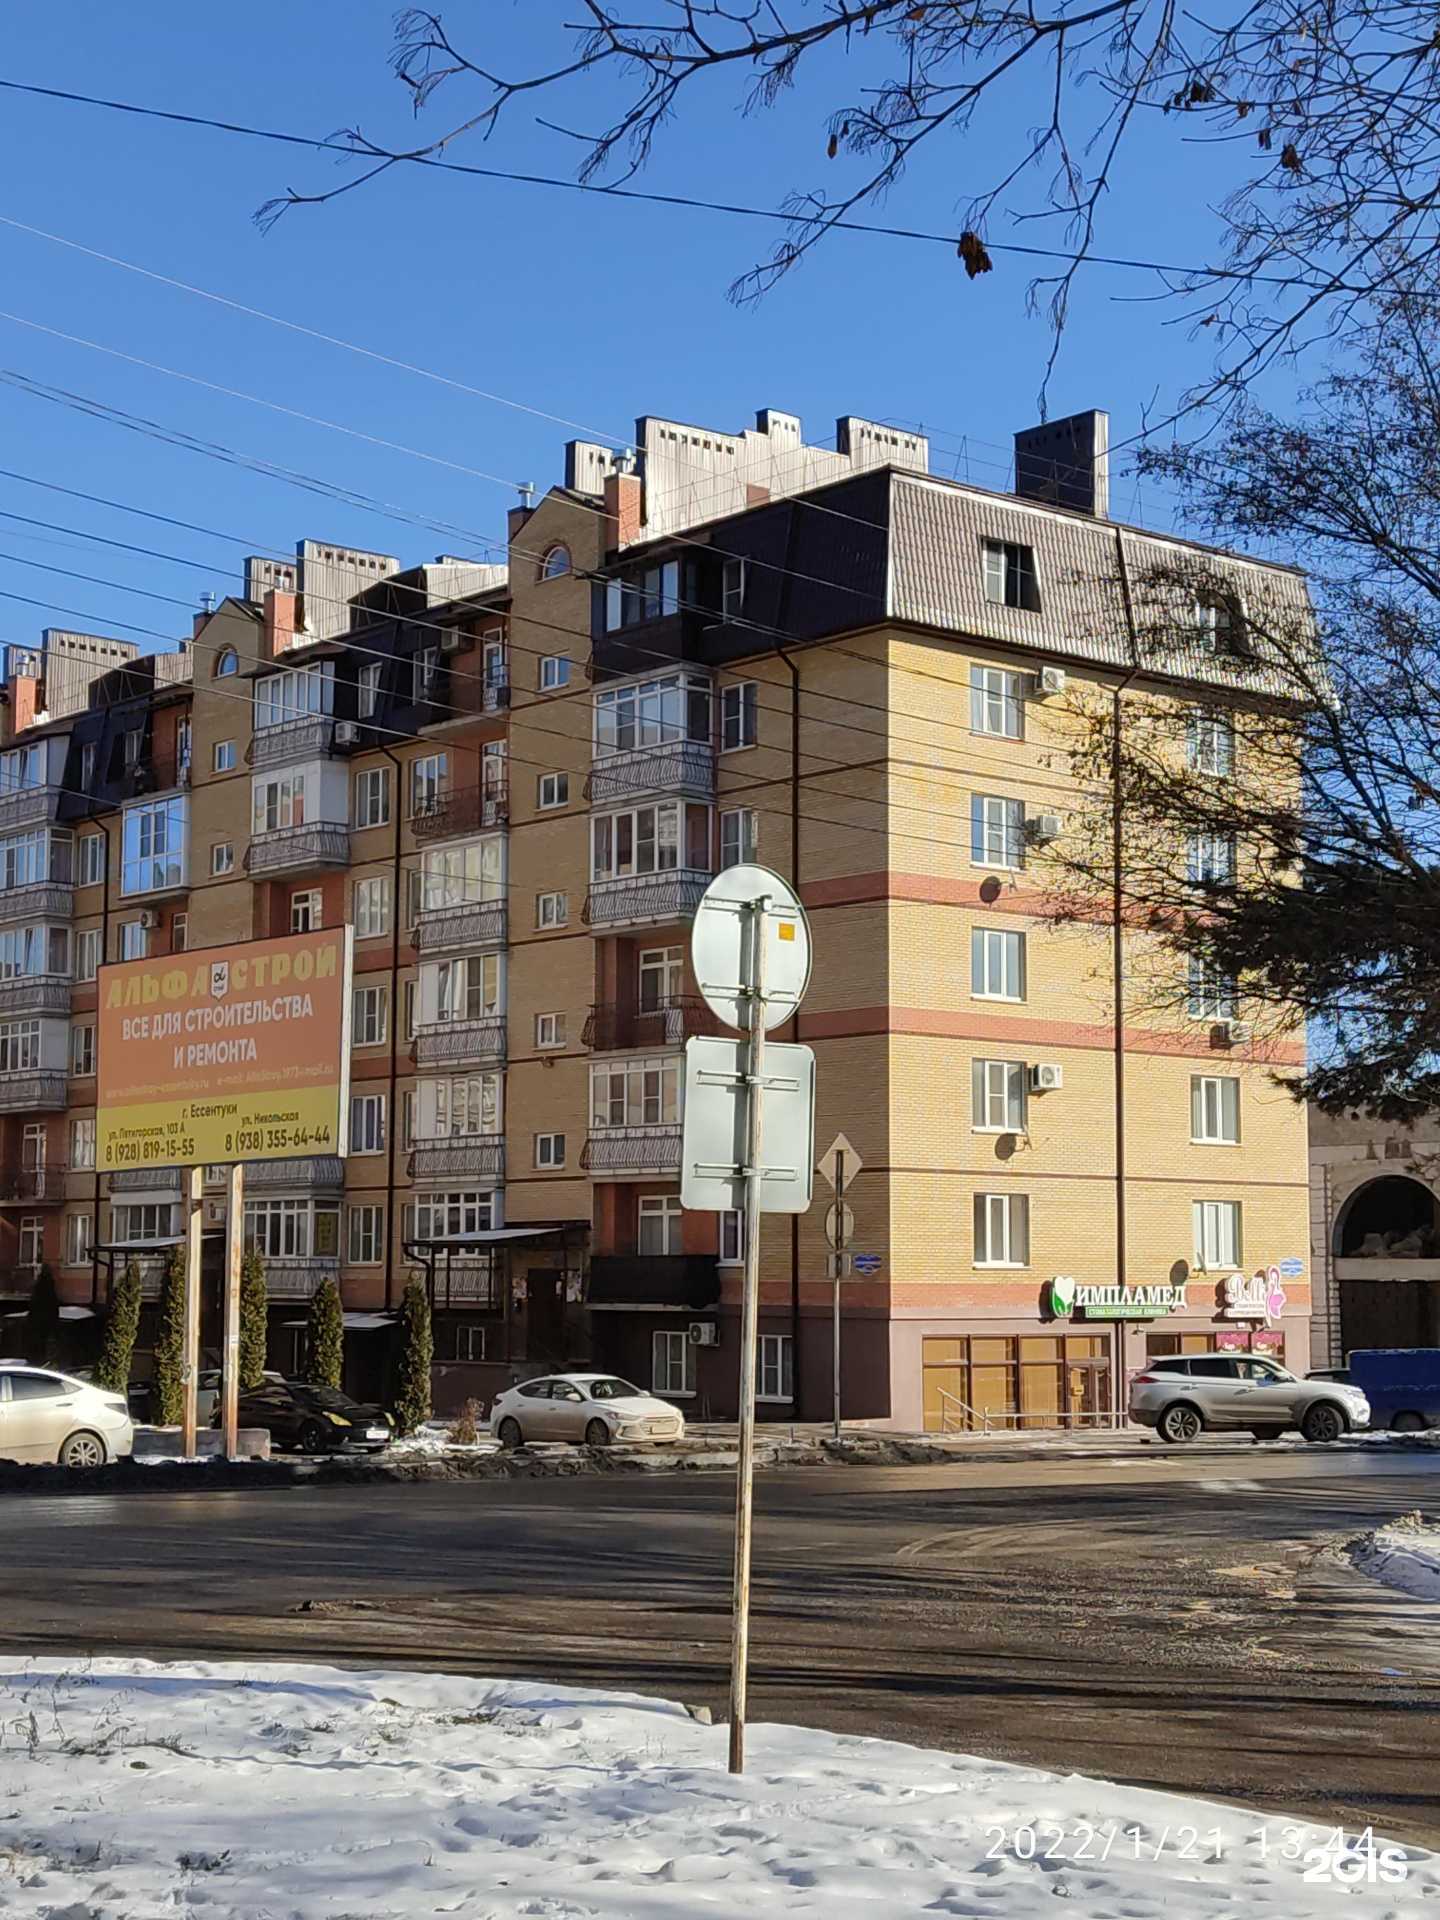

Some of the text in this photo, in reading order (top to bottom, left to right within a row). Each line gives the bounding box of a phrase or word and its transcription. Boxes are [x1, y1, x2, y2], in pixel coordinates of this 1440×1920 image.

[106, 943, 337, 1009] АЛЬФА СТРОЙ
[122, 993, 313, 1040] ВСЕ ДЛЯ СТРОИТЕЛЬСТВА
[174, 1038, 257, 1069] И РЕМОНТА
[190, 1103, 238, 1119] Ессентуки
[106, 1138, 195, 1162] 8 (928) 819-15-55
[225, 1125, 330, 1152] 8 (938) 355-64-44
[1075, 1285, 1188, 1311] ИМПЛАМЕД
